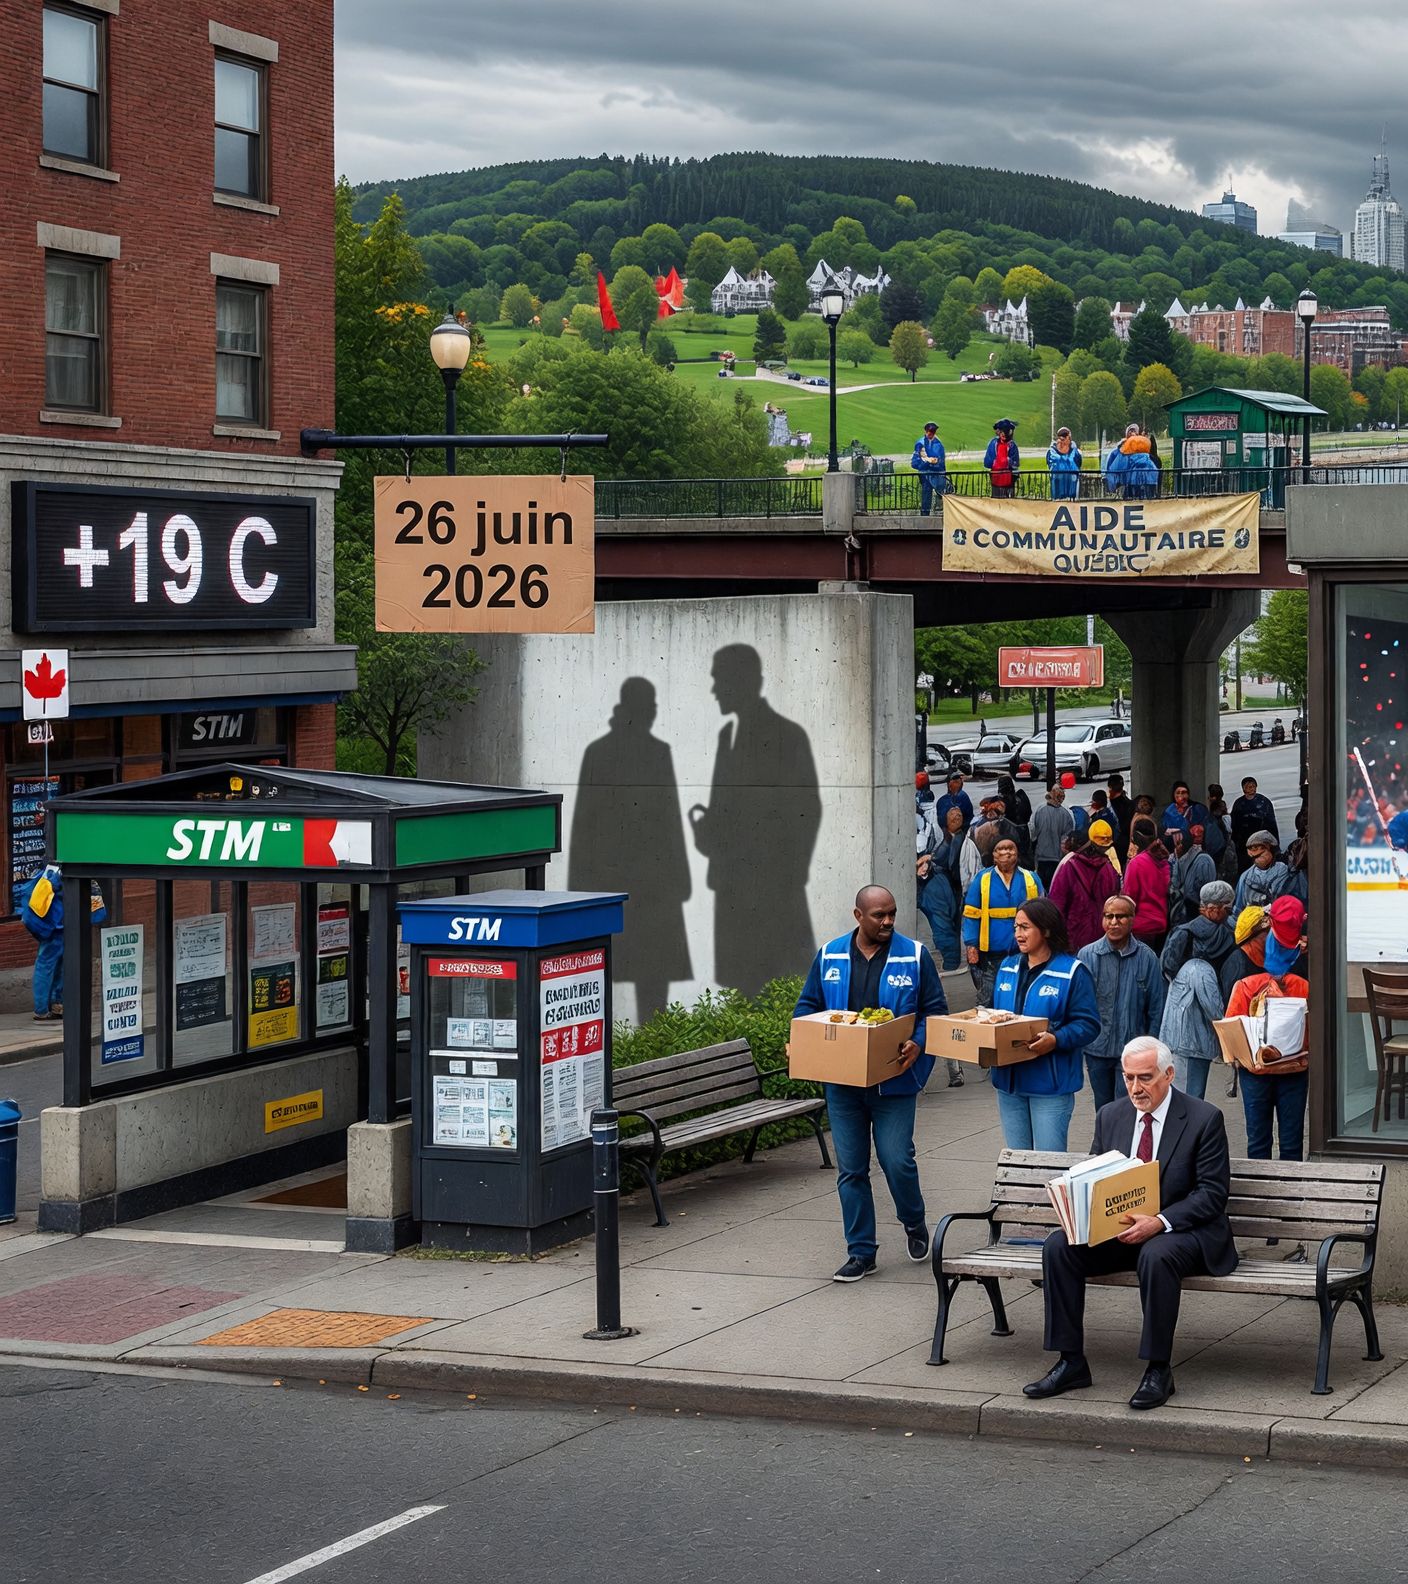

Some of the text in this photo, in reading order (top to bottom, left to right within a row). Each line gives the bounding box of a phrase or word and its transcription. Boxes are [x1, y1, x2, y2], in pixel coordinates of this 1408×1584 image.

[394, 500, 573, 556] 26 juin
[1049, 504, 1146, 532] AIDE
[63, 511, 279, 604] +19 C
[973, 527, 1226, 552] COMMUNAUTAIRE
[421, 563, 549, 609] 2026
[166, 819, 266, 861] STM
[448, 917, 502, 941] STM
